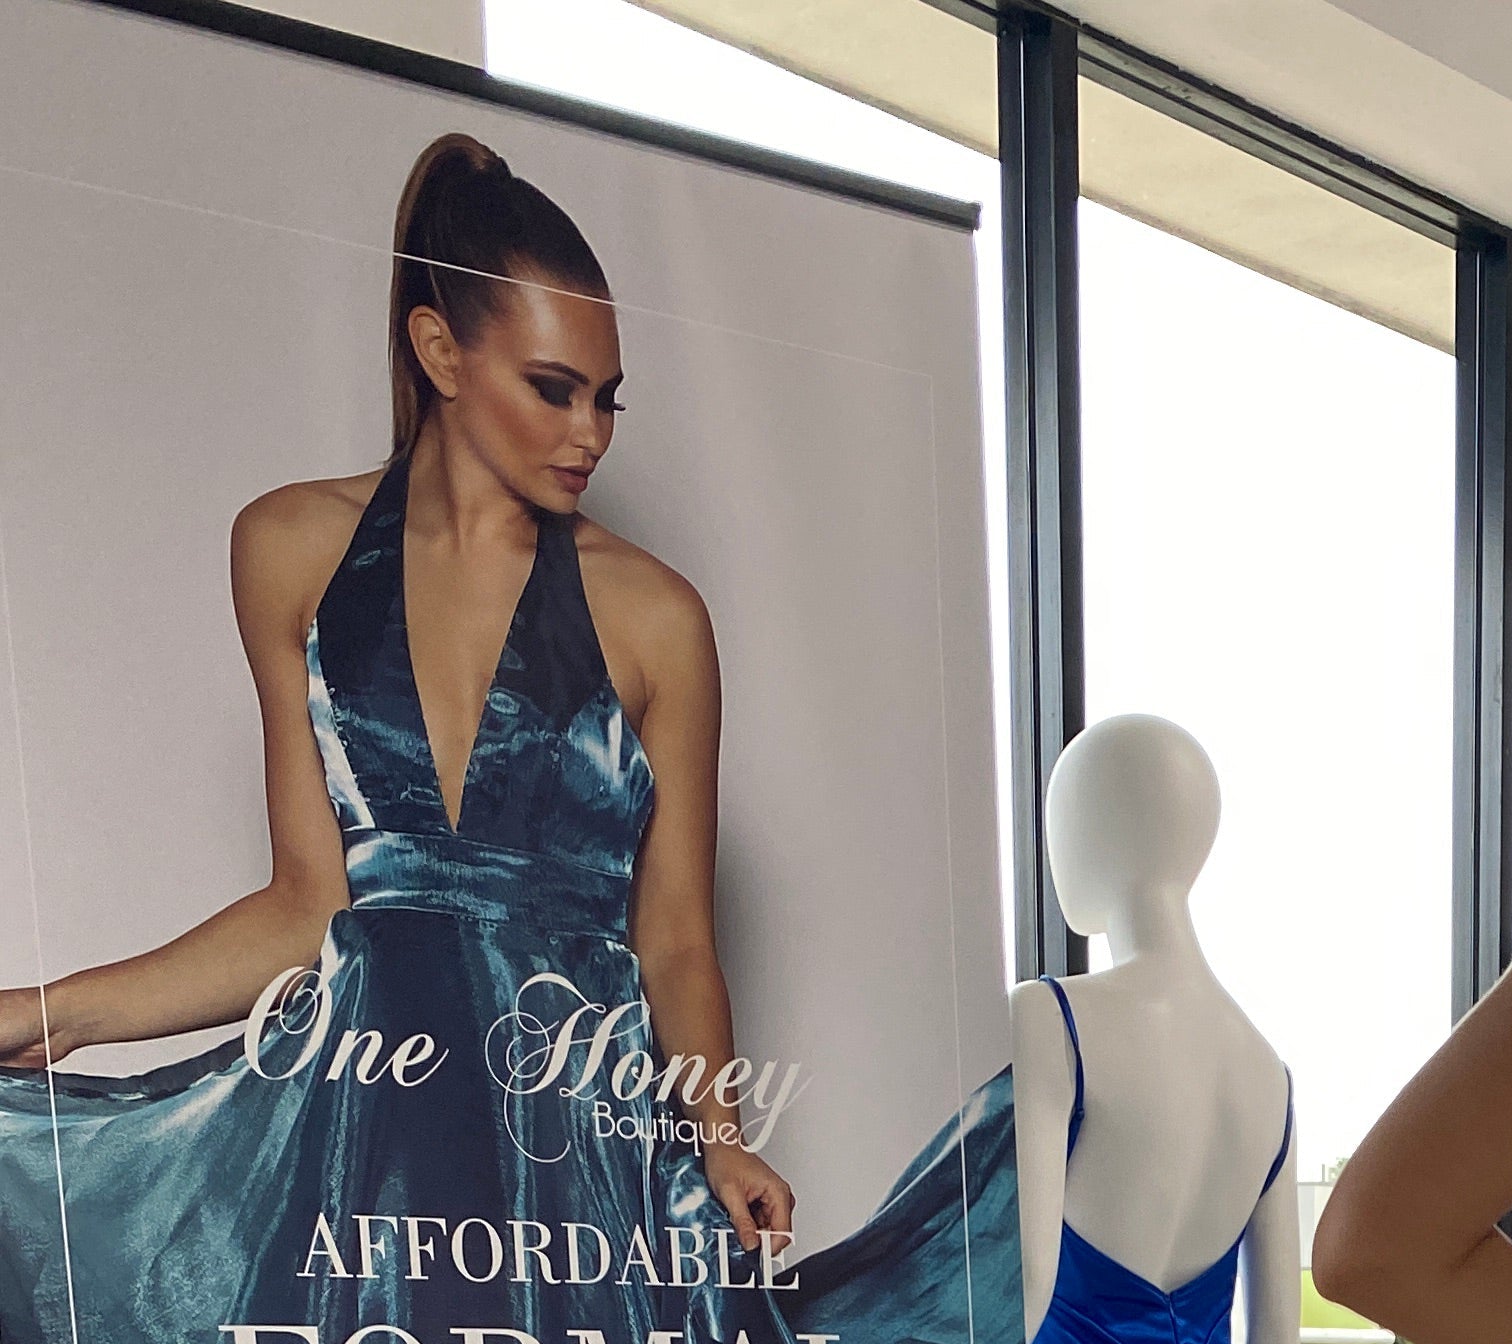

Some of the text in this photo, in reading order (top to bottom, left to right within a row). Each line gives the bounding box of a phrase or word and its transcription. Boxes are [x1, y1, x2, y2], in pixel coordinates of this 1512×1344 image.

[243, 966, 815, 1163] One Honey
[592, 1101, 738, 1157] Boutique
[296, 1212, 800, 1291] AFFORDABLE
